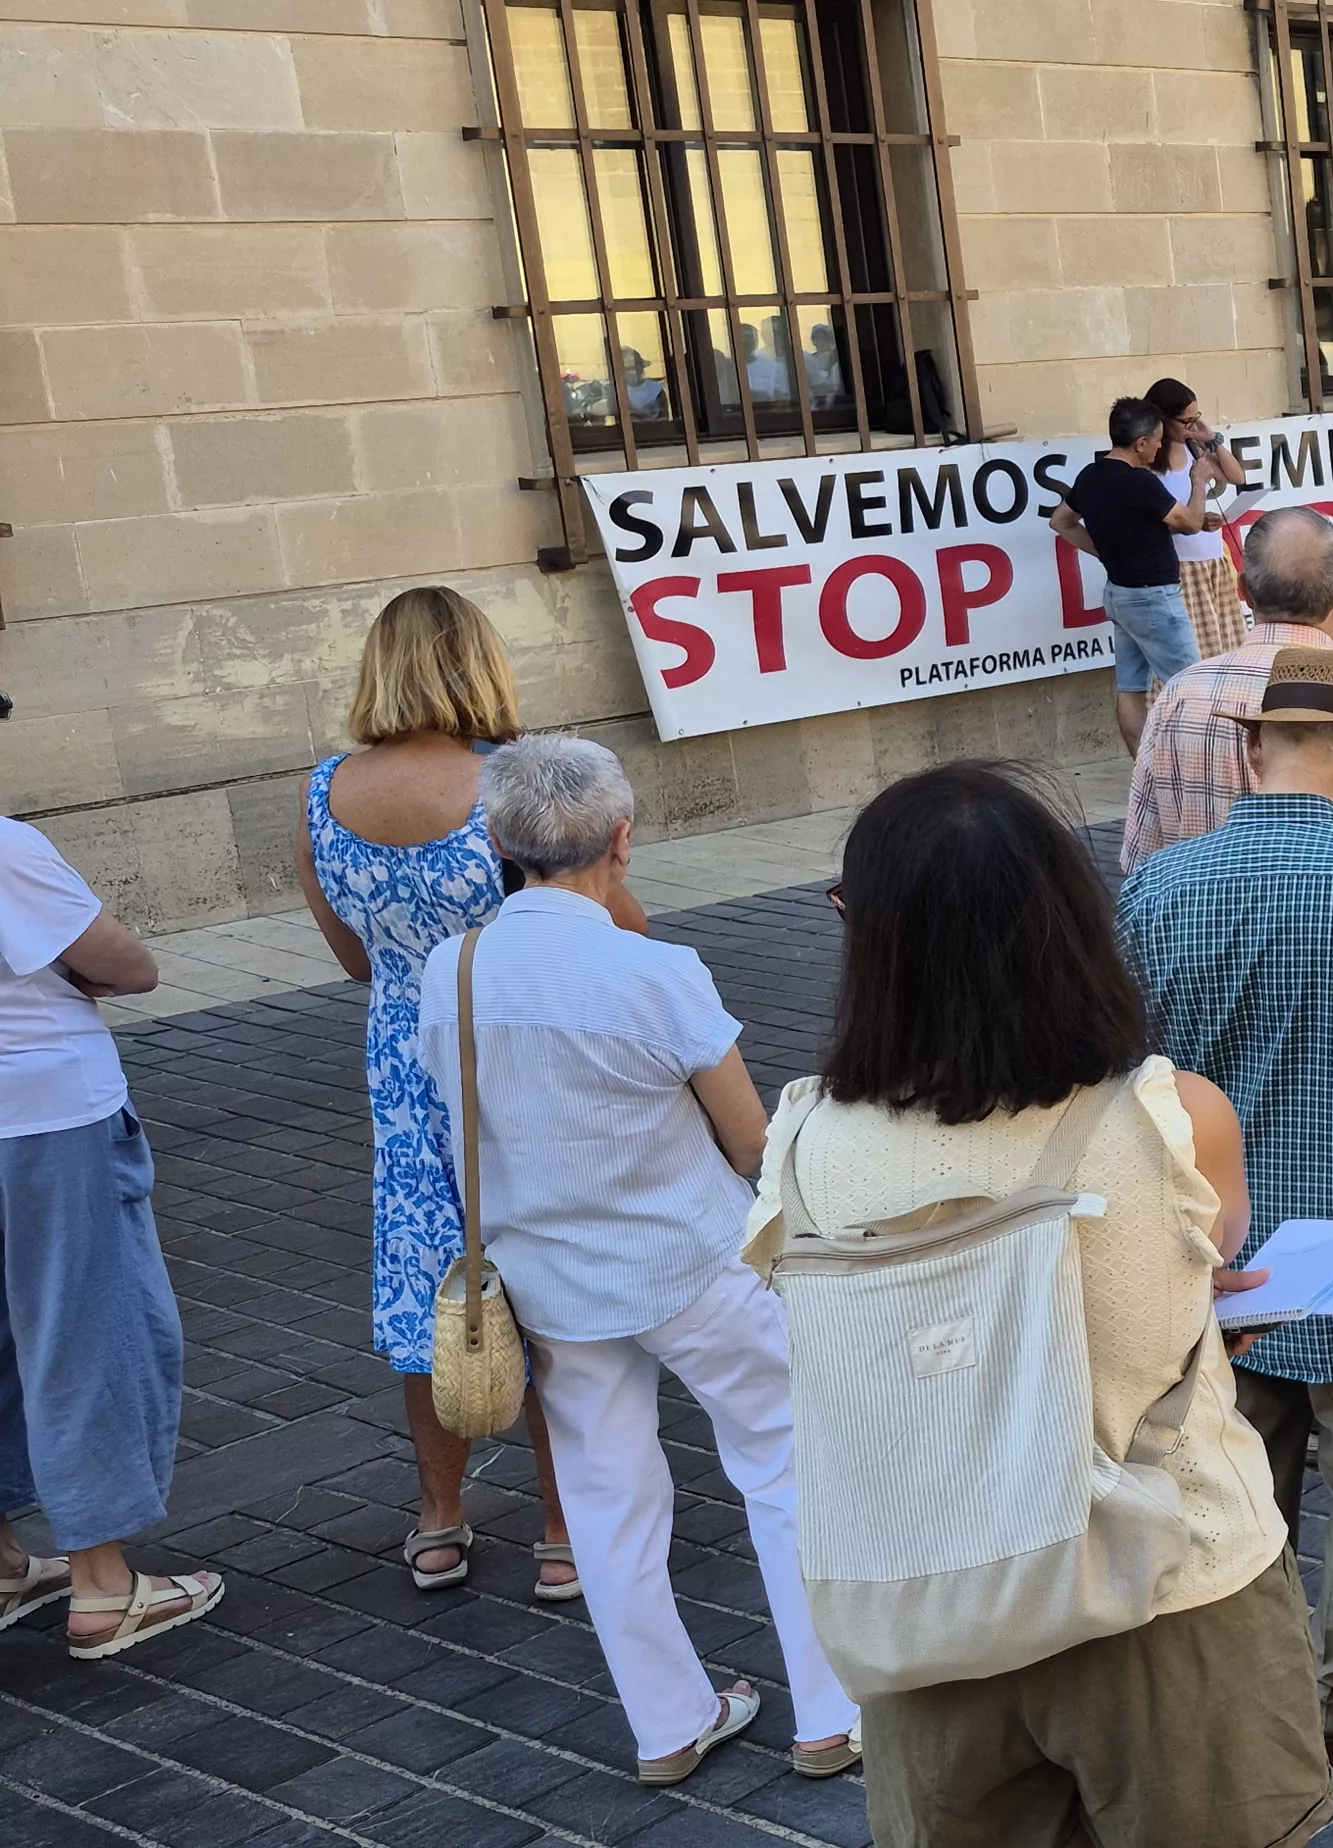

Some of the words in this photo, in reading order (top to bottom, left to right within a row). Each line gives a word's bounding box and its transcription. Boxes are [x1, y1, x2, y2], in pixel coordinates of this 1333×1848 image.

[608, 454, 1069, 562] SALVEMOS
[630, 543, 1015, 689] STOP
[900, 650, 1046, 688] PLATAFORMA
[1050, 637, 1104, 665] PARA
[933, 1341, 944, 1349] LA
